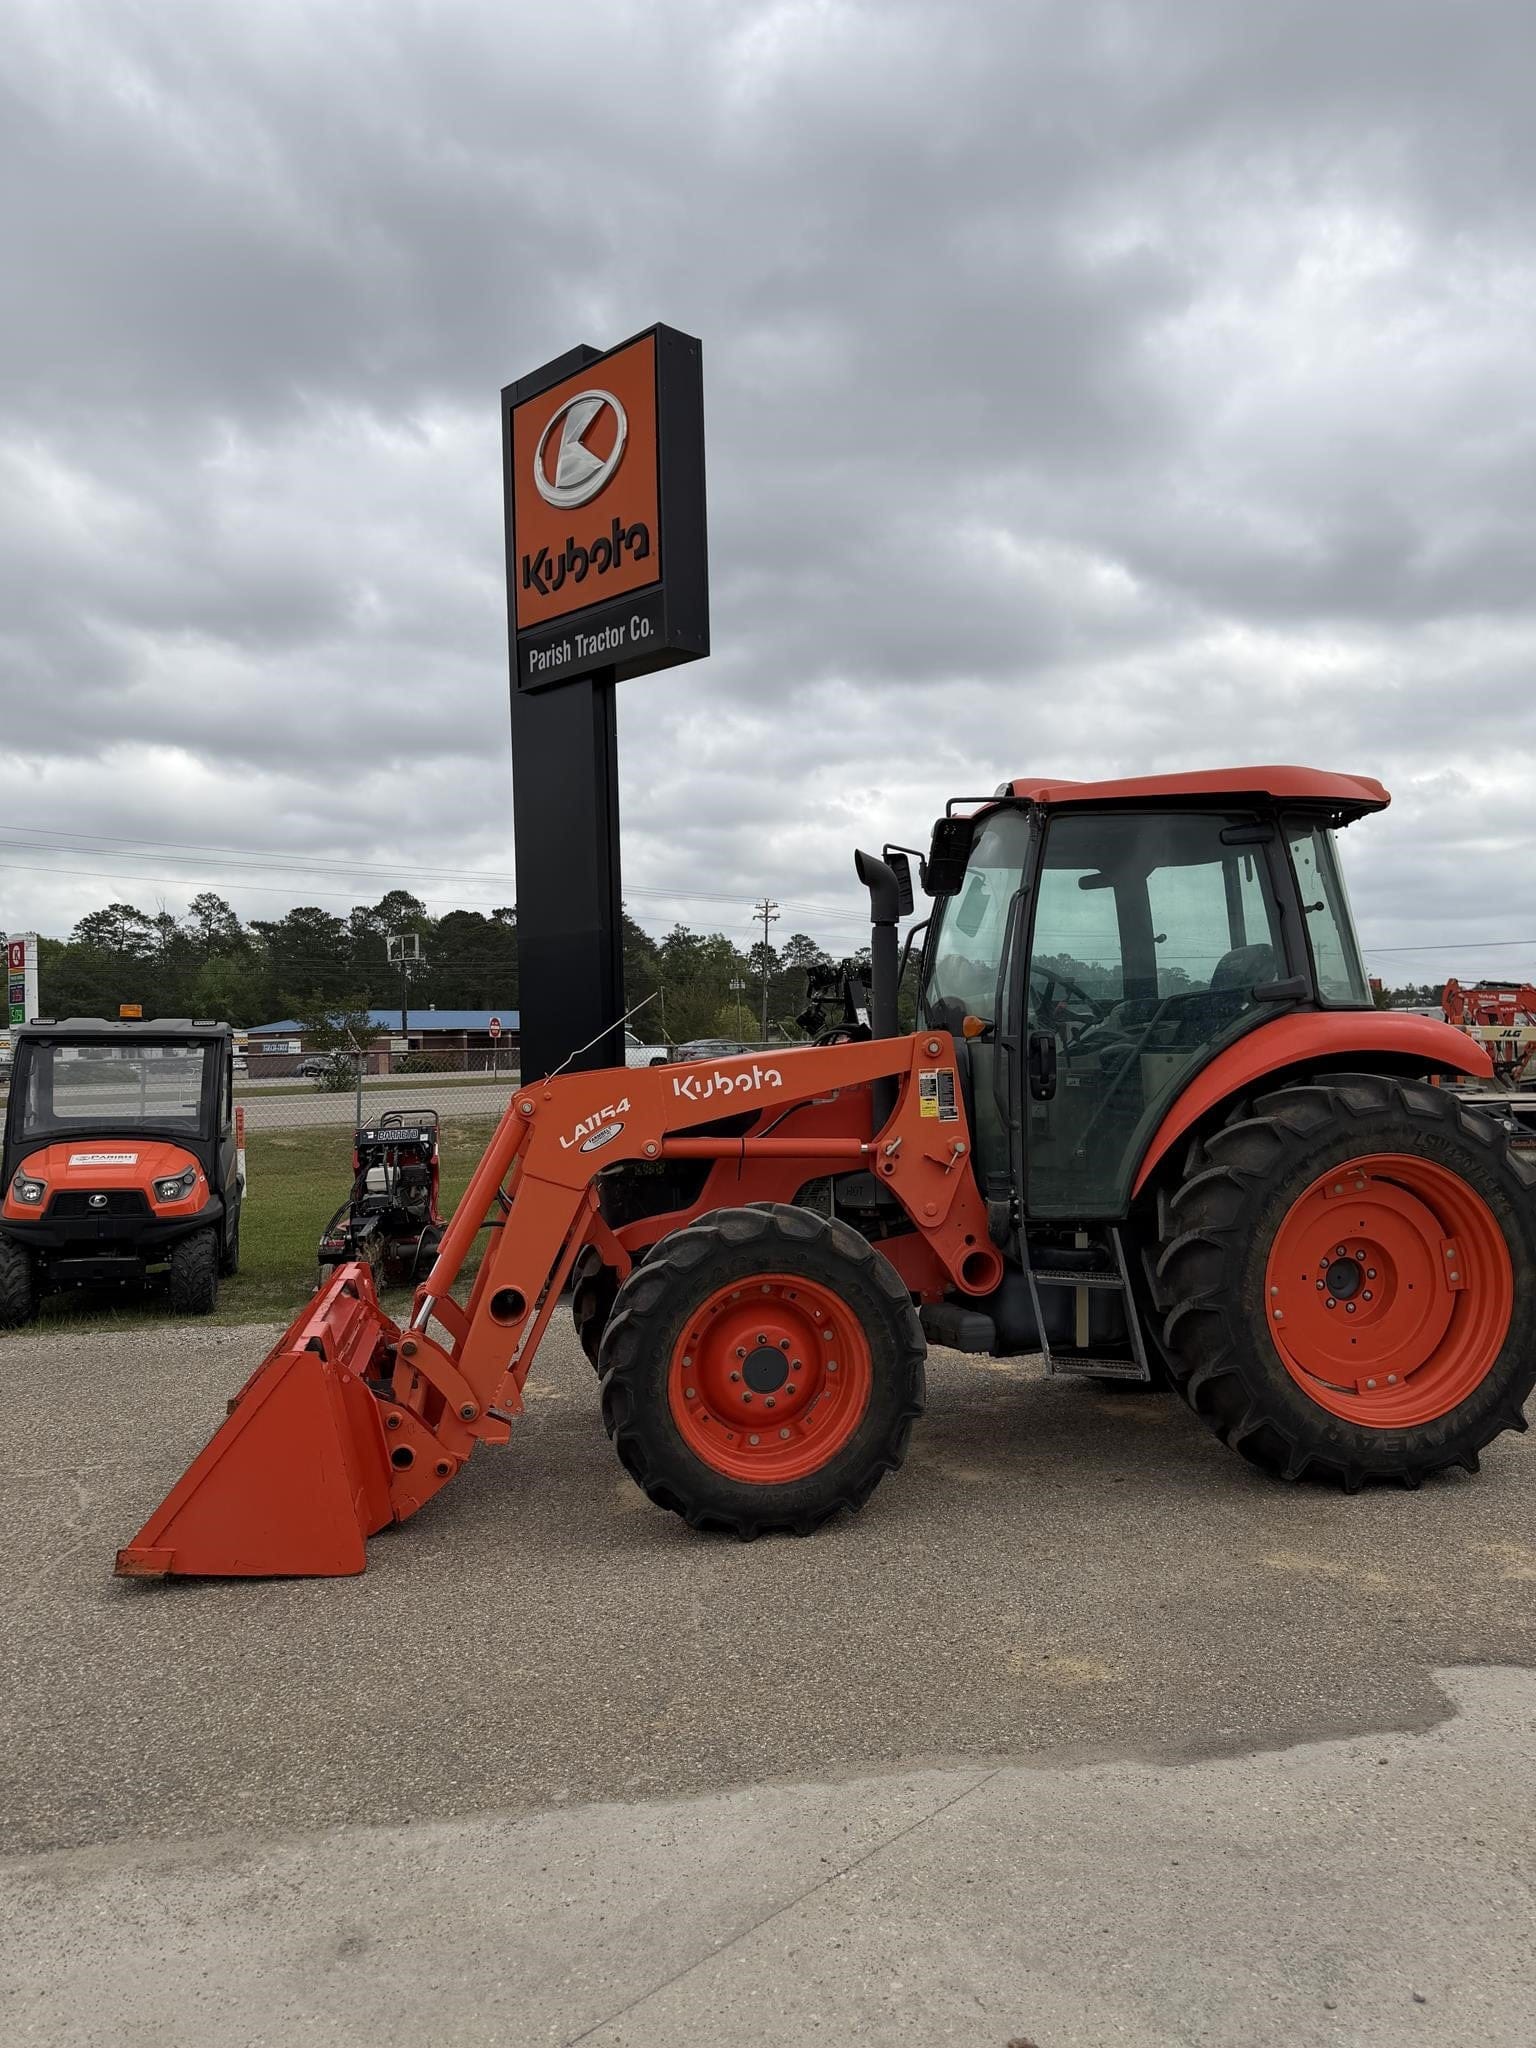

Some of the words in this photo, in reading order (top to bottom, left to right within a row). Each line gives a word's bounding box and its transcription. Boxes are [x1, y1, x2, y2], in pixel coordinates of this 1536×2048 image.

[522, 516, 650, 596] Kubota
[529, 640, 571, 672] Parish
[575, 625, 626, 658] Tractor
[630, 615, 654, 641] Co.
[1499, 1029, 1522, 1038] JLG
[672, 1064, 782, 1101] Kubota
[377, 1128, 419, 1141] BARRETO
[559, 1097, 631, 1149] LA1154
